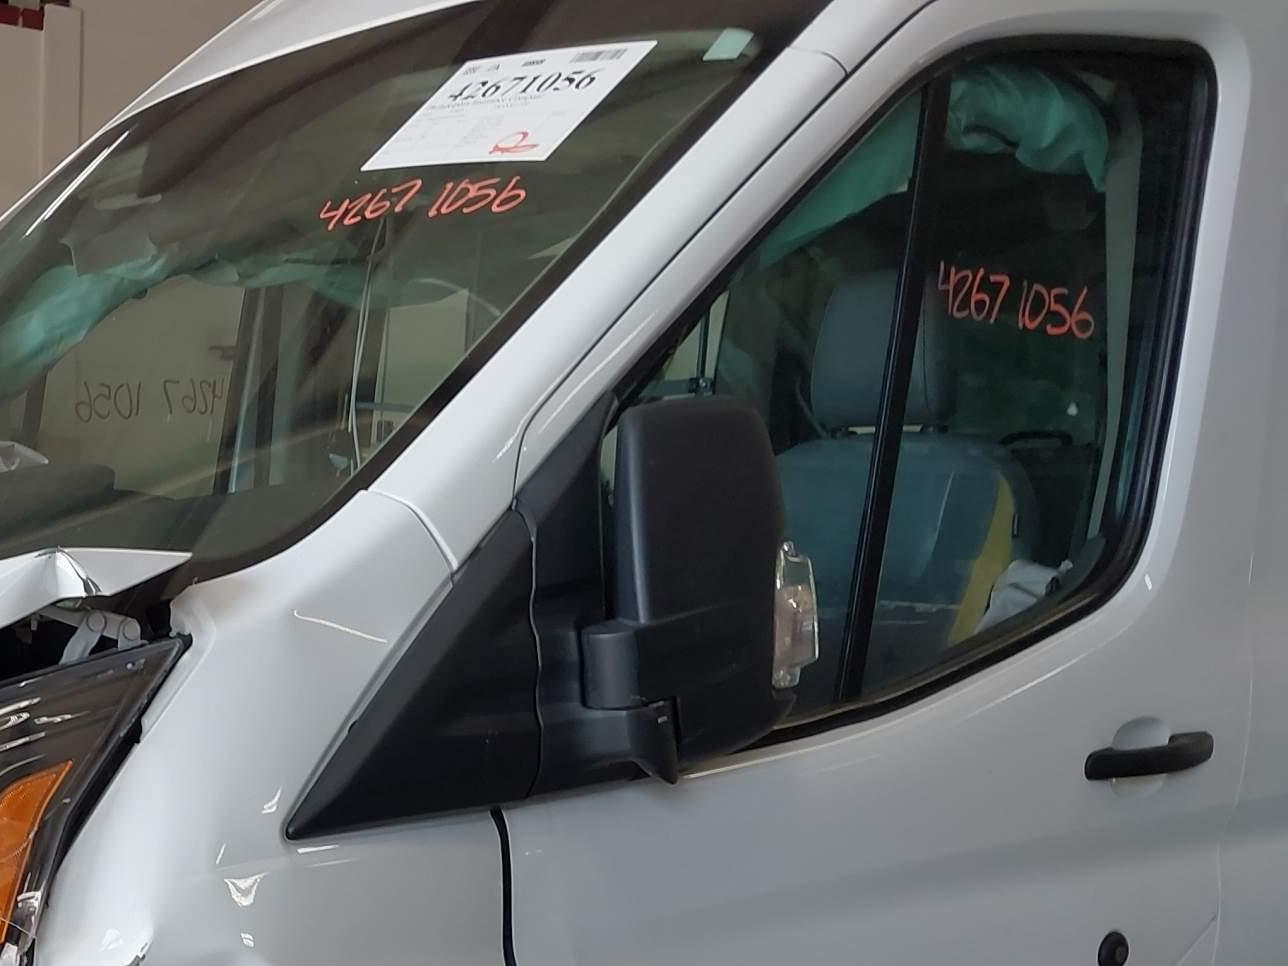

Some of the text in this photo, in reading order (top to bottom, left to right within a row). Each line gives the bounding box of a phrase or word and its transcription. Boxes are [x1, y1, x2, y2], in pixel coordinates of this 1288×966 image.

[448, 67, 605, 102] 42671056
[318, 175, 527, 232] 4267 1056
[937, 260, 1096, 340] 4267 1056
